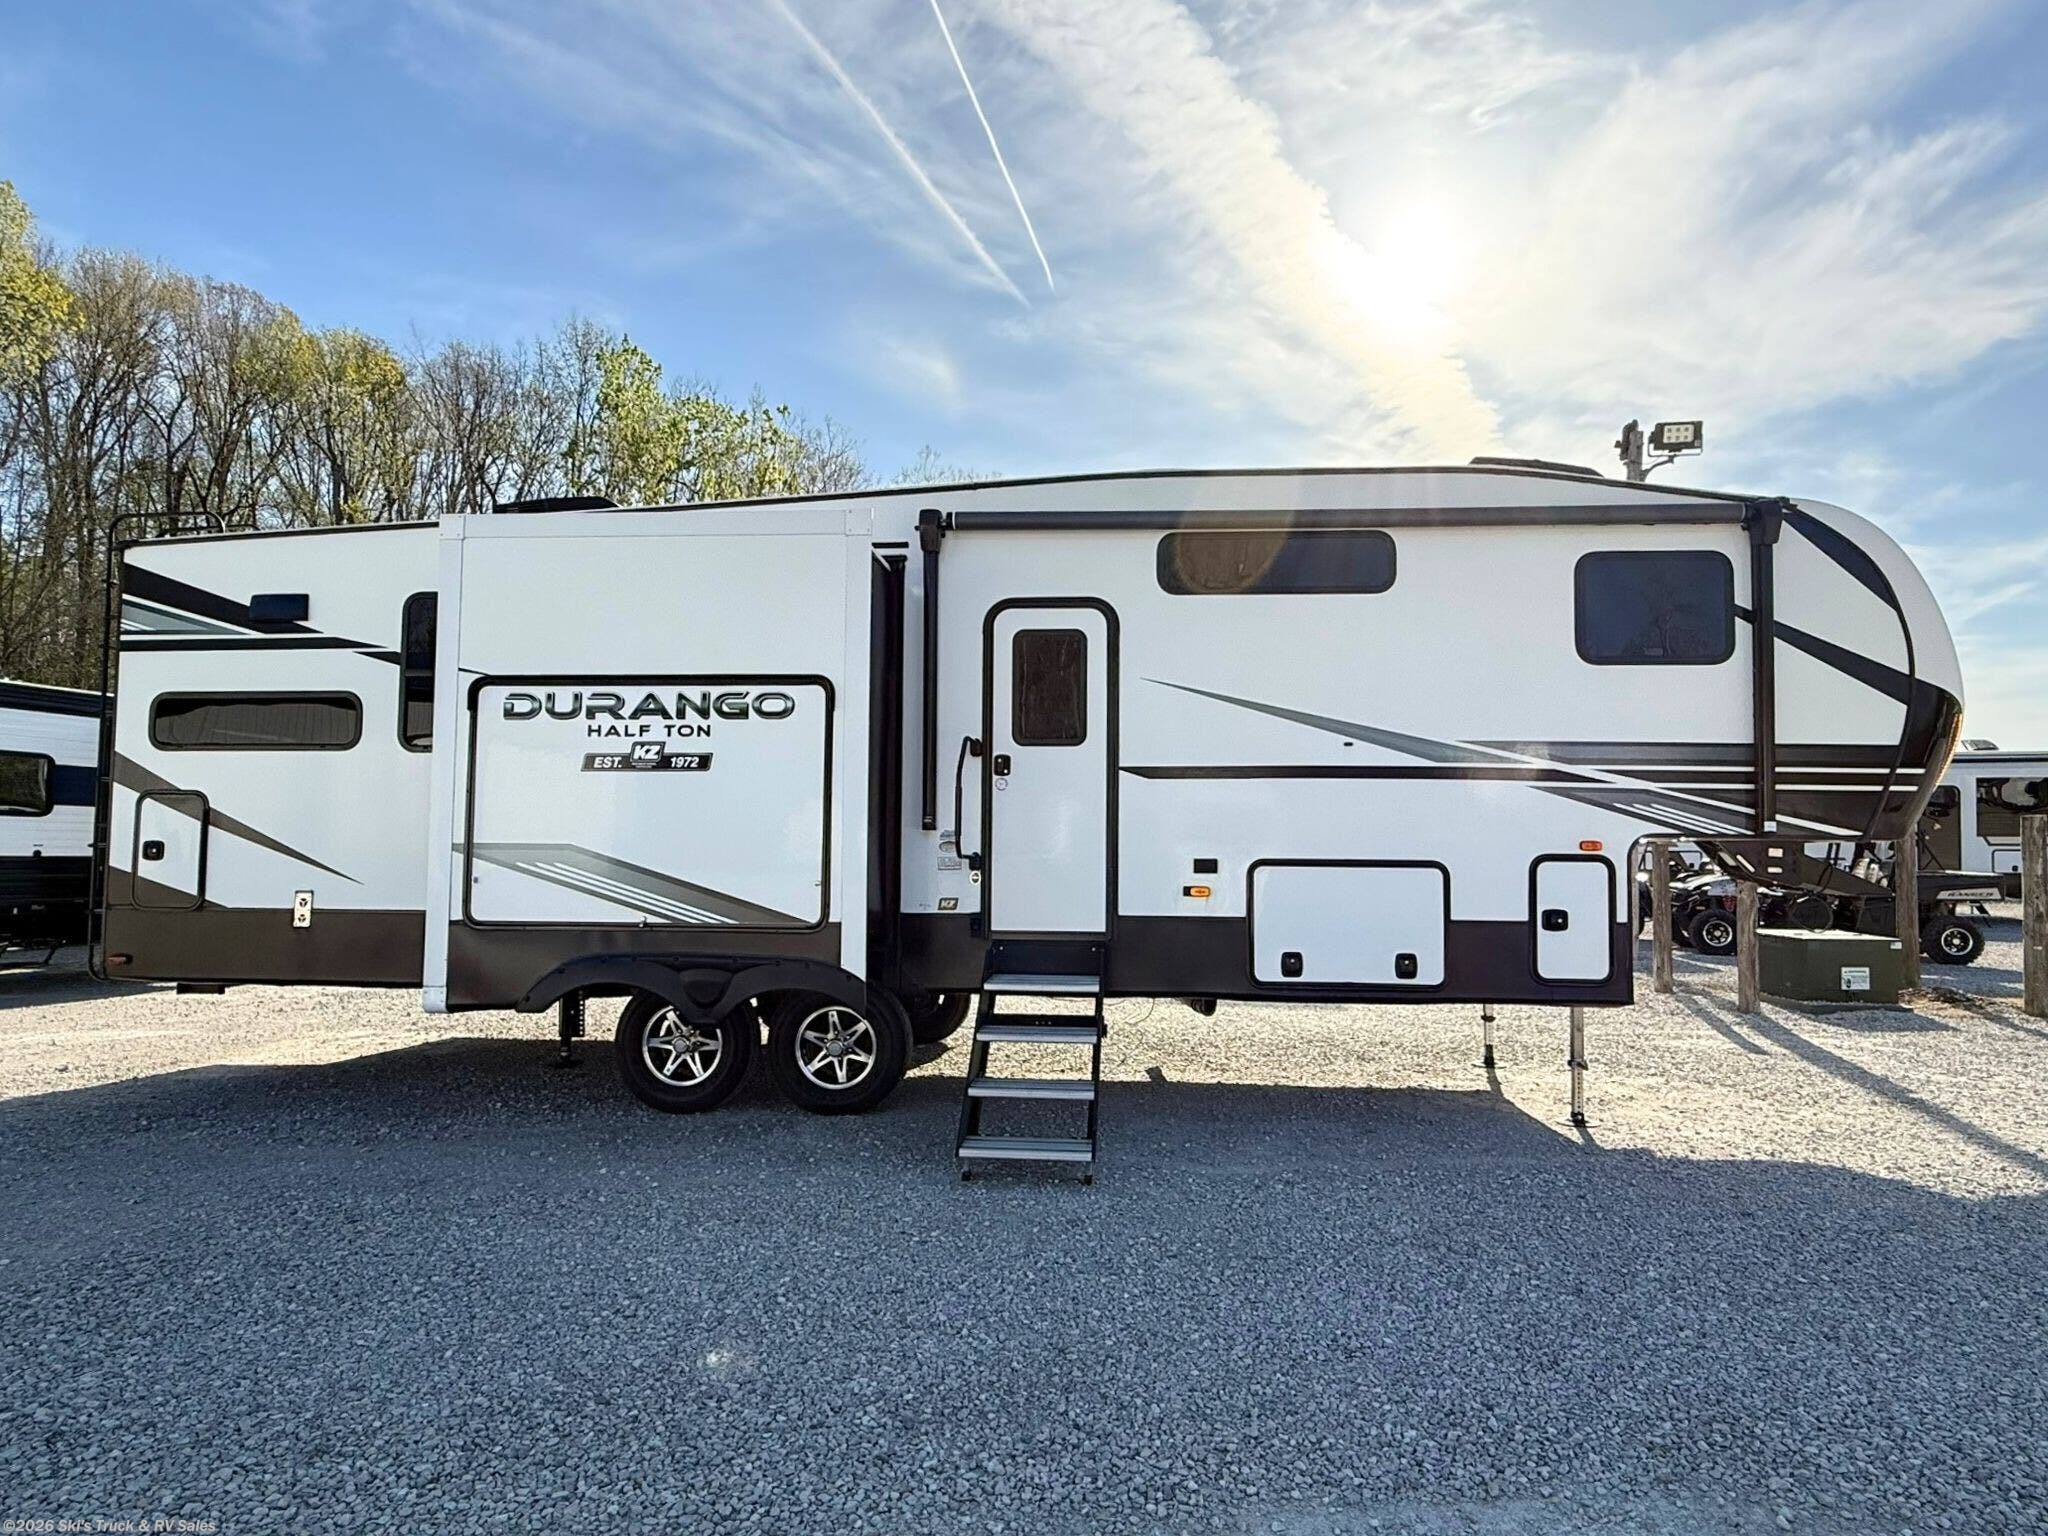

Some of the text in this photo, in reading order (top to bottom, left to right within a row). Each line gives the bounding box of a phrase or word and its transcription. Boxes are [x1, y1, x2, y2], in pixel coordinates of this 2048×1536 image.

[503, 690, 796, 720] DURANGO
[587, 724, 712, 737] HALF TON
[633, 744, 661, 760] KZ
[593, 756, 622, 768] EST.
[670, 756, 699, 768] 1972
